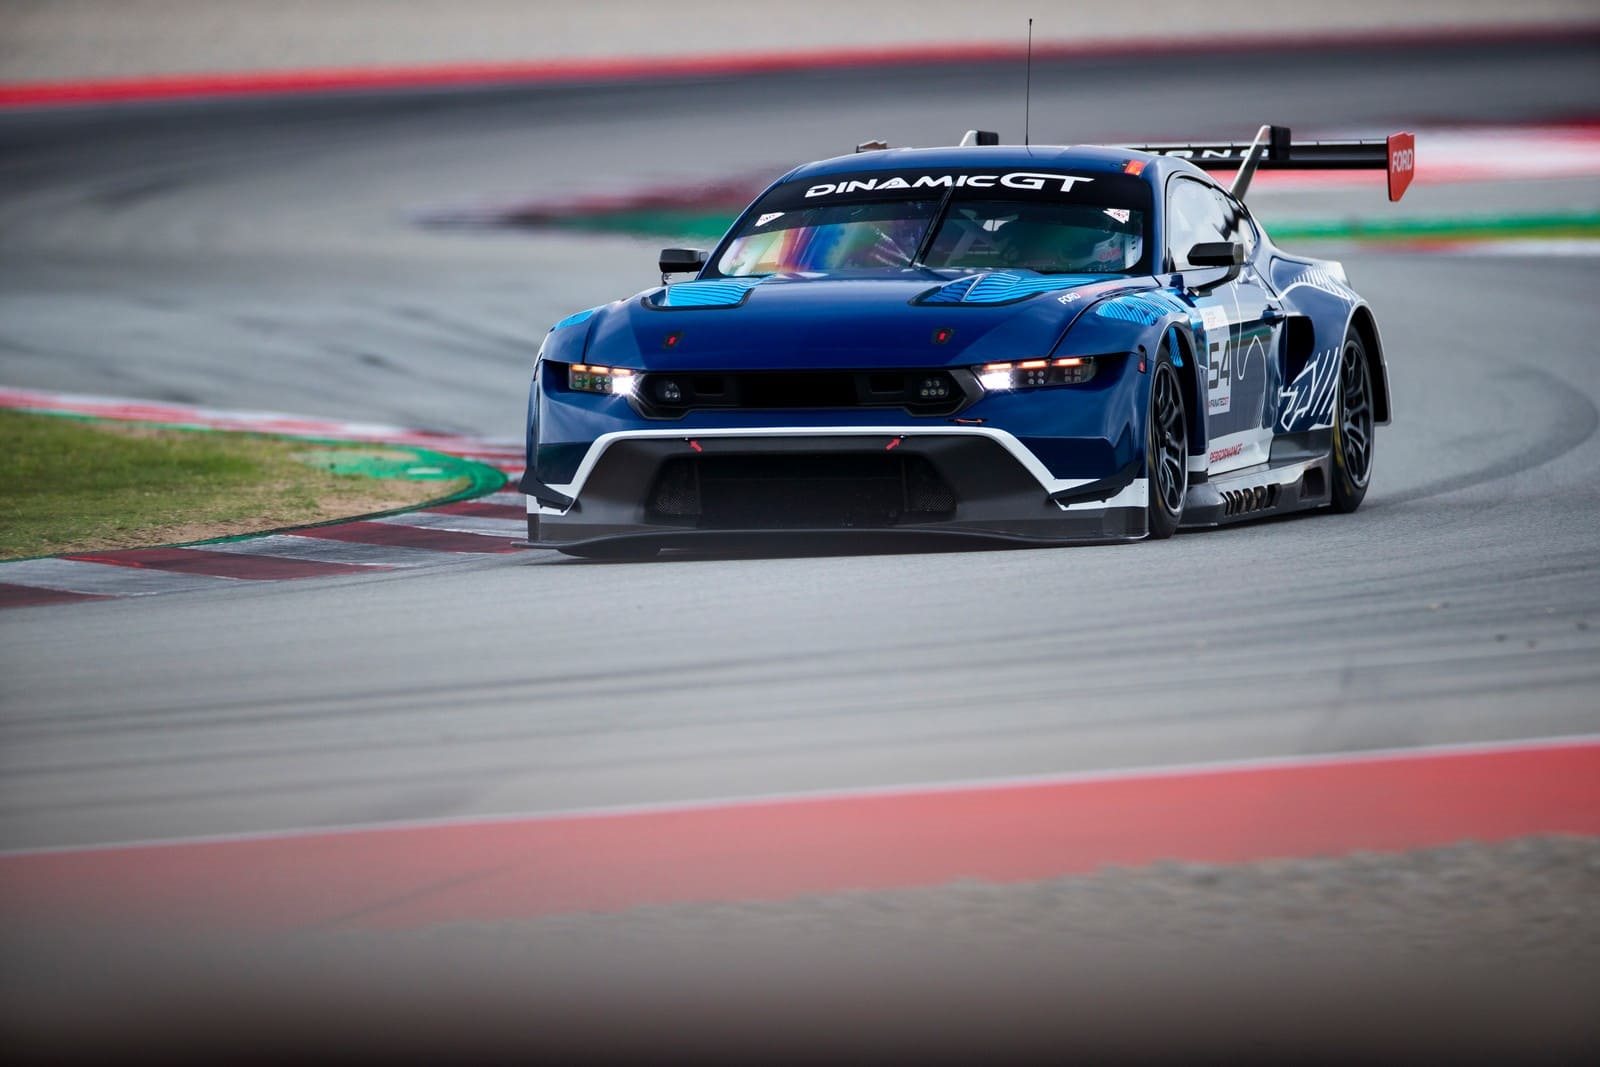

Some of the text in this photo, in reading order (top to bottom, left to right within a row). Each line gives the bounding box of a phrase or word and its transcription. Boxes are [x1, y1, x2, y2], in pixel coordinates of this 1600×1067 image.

[1391, 148, 1414, 173] FORD
[1057, 292, 1081, 305] FORD
[1208, 340, 1231, 390] 54
